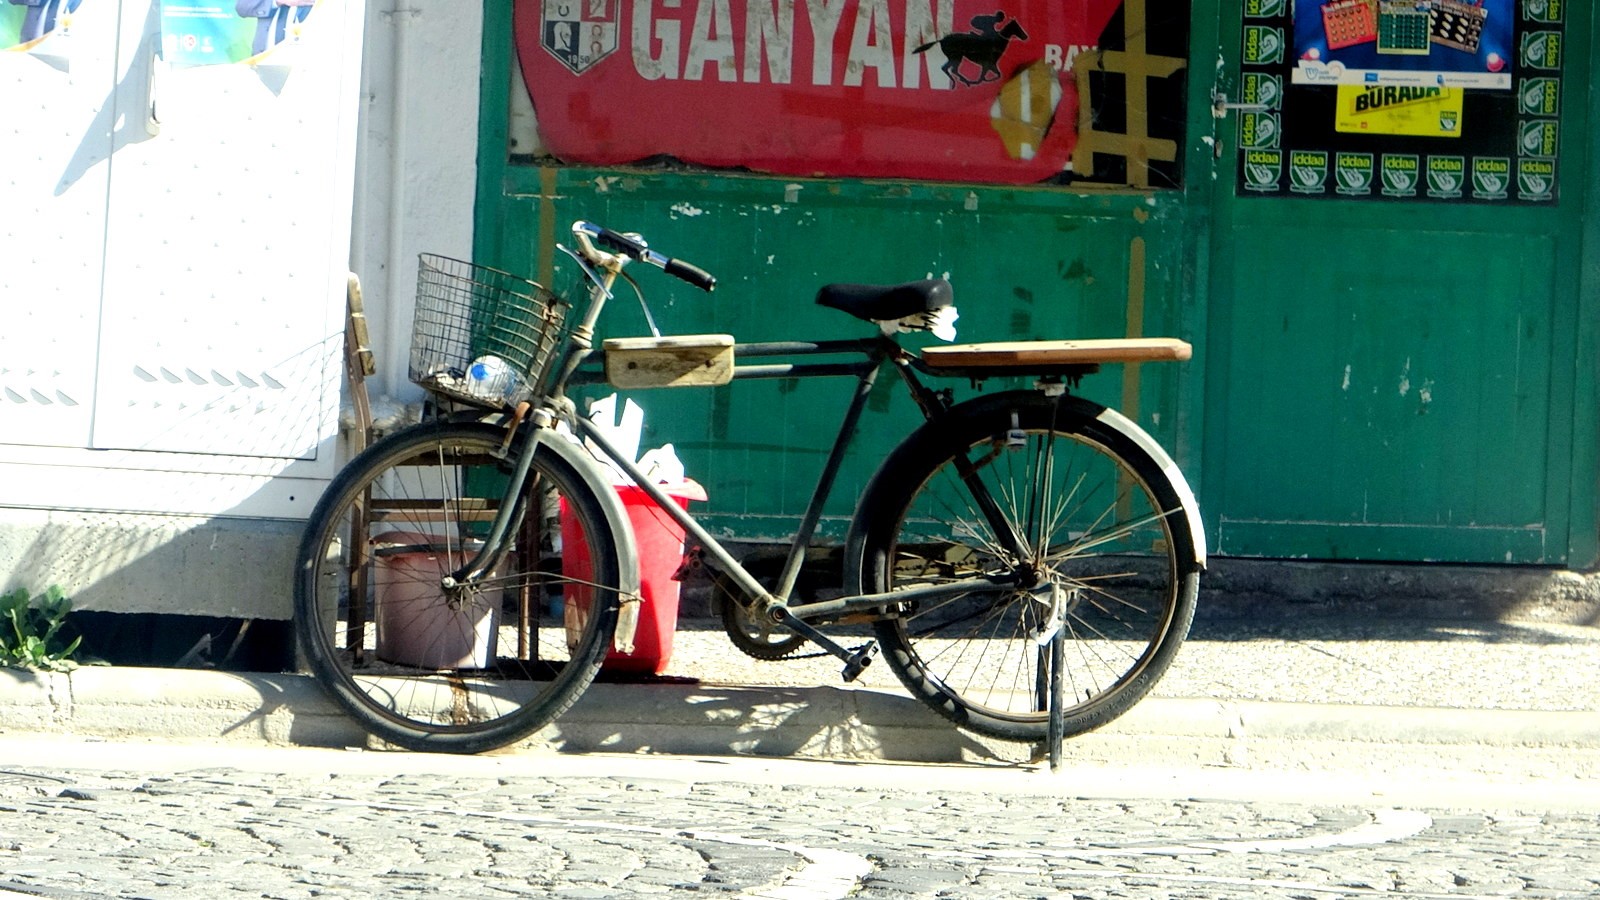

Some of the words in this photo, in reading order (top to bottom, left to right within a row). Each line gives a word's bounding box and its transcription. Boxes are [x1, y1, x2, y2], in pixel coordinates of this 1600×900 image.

[631, 0, 955, 90] GANYAN
[1044, 44, 1099, 72] BA
[1246, 29, 1258, 61] iddaa
[1547, 34, 1559, 67] iddaa
[1244, 76, 1256, 105] ddaa
[1545, 81, 1557, 113] iddaa
[1242, 114, 1254, 146] iddaa
[1543, 123, 1555, 154] iddaa
[1248, 152, 1279, 164] iddaa
[1293, 153, 1324, 166] iddaa
[1340, 155, 1370, 167] iddaa
[1385, 157, 1416, 169] iddaa
[1430, 158, 1461, 170] iddaa
[1476, 160, 1507, 172] iddaa
[1521, 161, 1552, 173] iddaa
